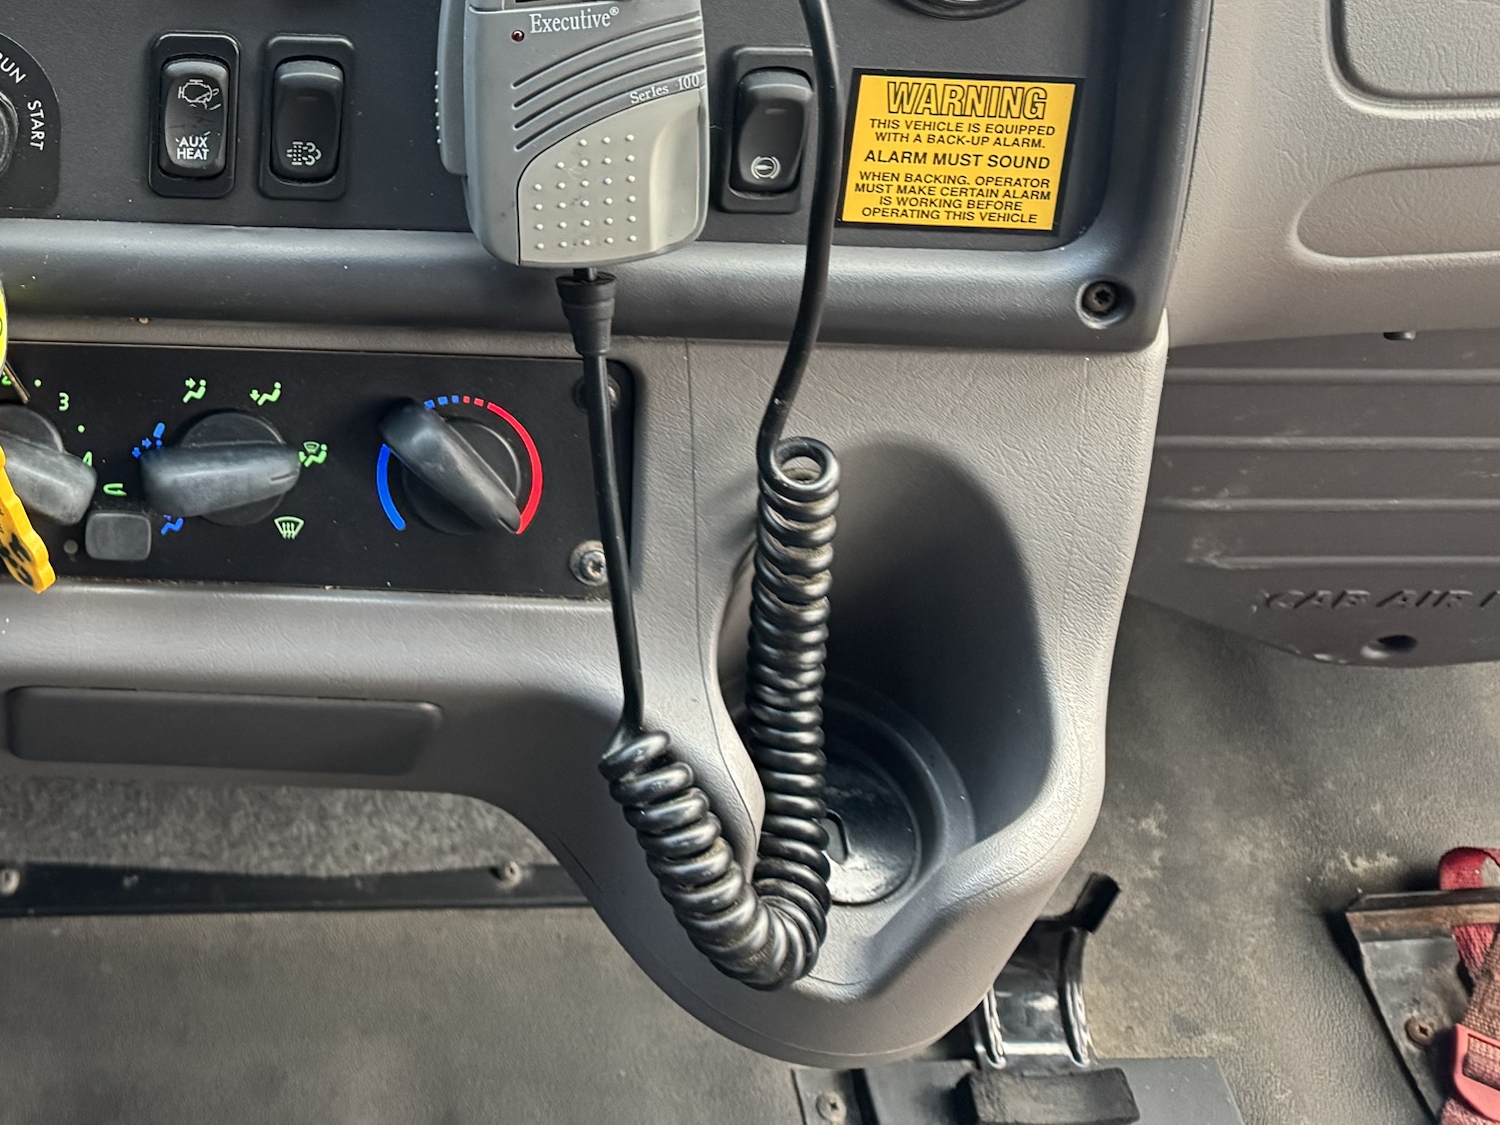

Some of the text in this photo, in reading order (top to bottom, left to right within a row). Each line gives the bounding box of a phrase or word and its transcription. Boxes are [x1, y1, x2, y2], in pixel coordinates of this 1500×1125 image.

[529, 8, 611, 34] Executive
[629, 75, 700, 105] Series 100
[887, 82, 1048, 120] WARNING
[27, 100, 45, 151] START
[869, 119, 1056, 136] THIS VEHICLE IS EQUIPPED
[179, 136, 208, 148] AUX
[875, 132, 1046, 148] WITH A BACK-UP ALARM.
[177, 149, 209, 160] HEAT
[864, 150, 1051, 169] ALARM MUST SOUND
[859, 171, 1050, 188] WHEN OPERATOR
[854, 183, 1051, 200] MUST MAKE CERTAIN ALARM
[879, 197, 1023, 211] IS WORKING BEFORE
[862, 208, 1038, 224] OPERATING THIS VEHICLE
[58, 392, 69, 411] 3
